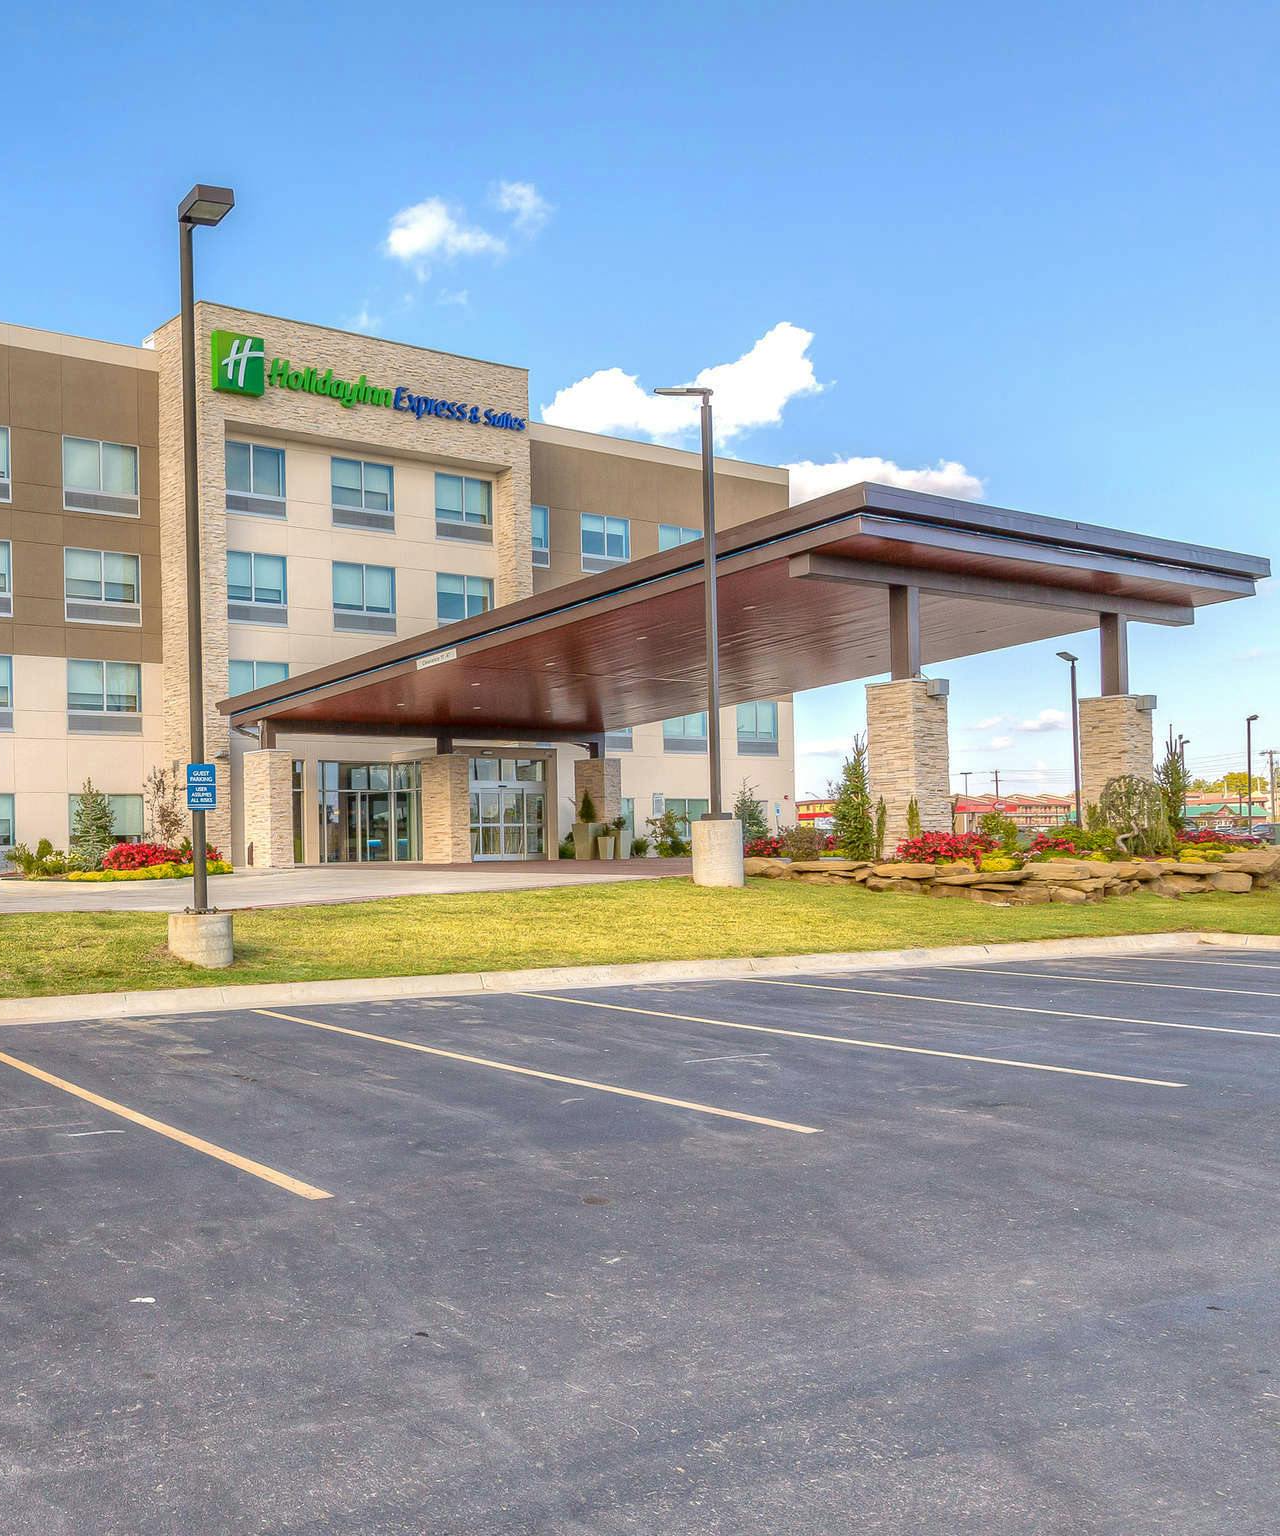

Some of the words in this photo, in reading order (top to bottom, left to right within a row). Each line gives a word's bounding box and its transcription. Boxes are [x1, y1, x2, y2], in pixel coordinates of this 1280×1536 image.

[392, 386, 468, 420] Express
[469, 405, 481, 424] &
[483, 408, 526, 431] Suites
